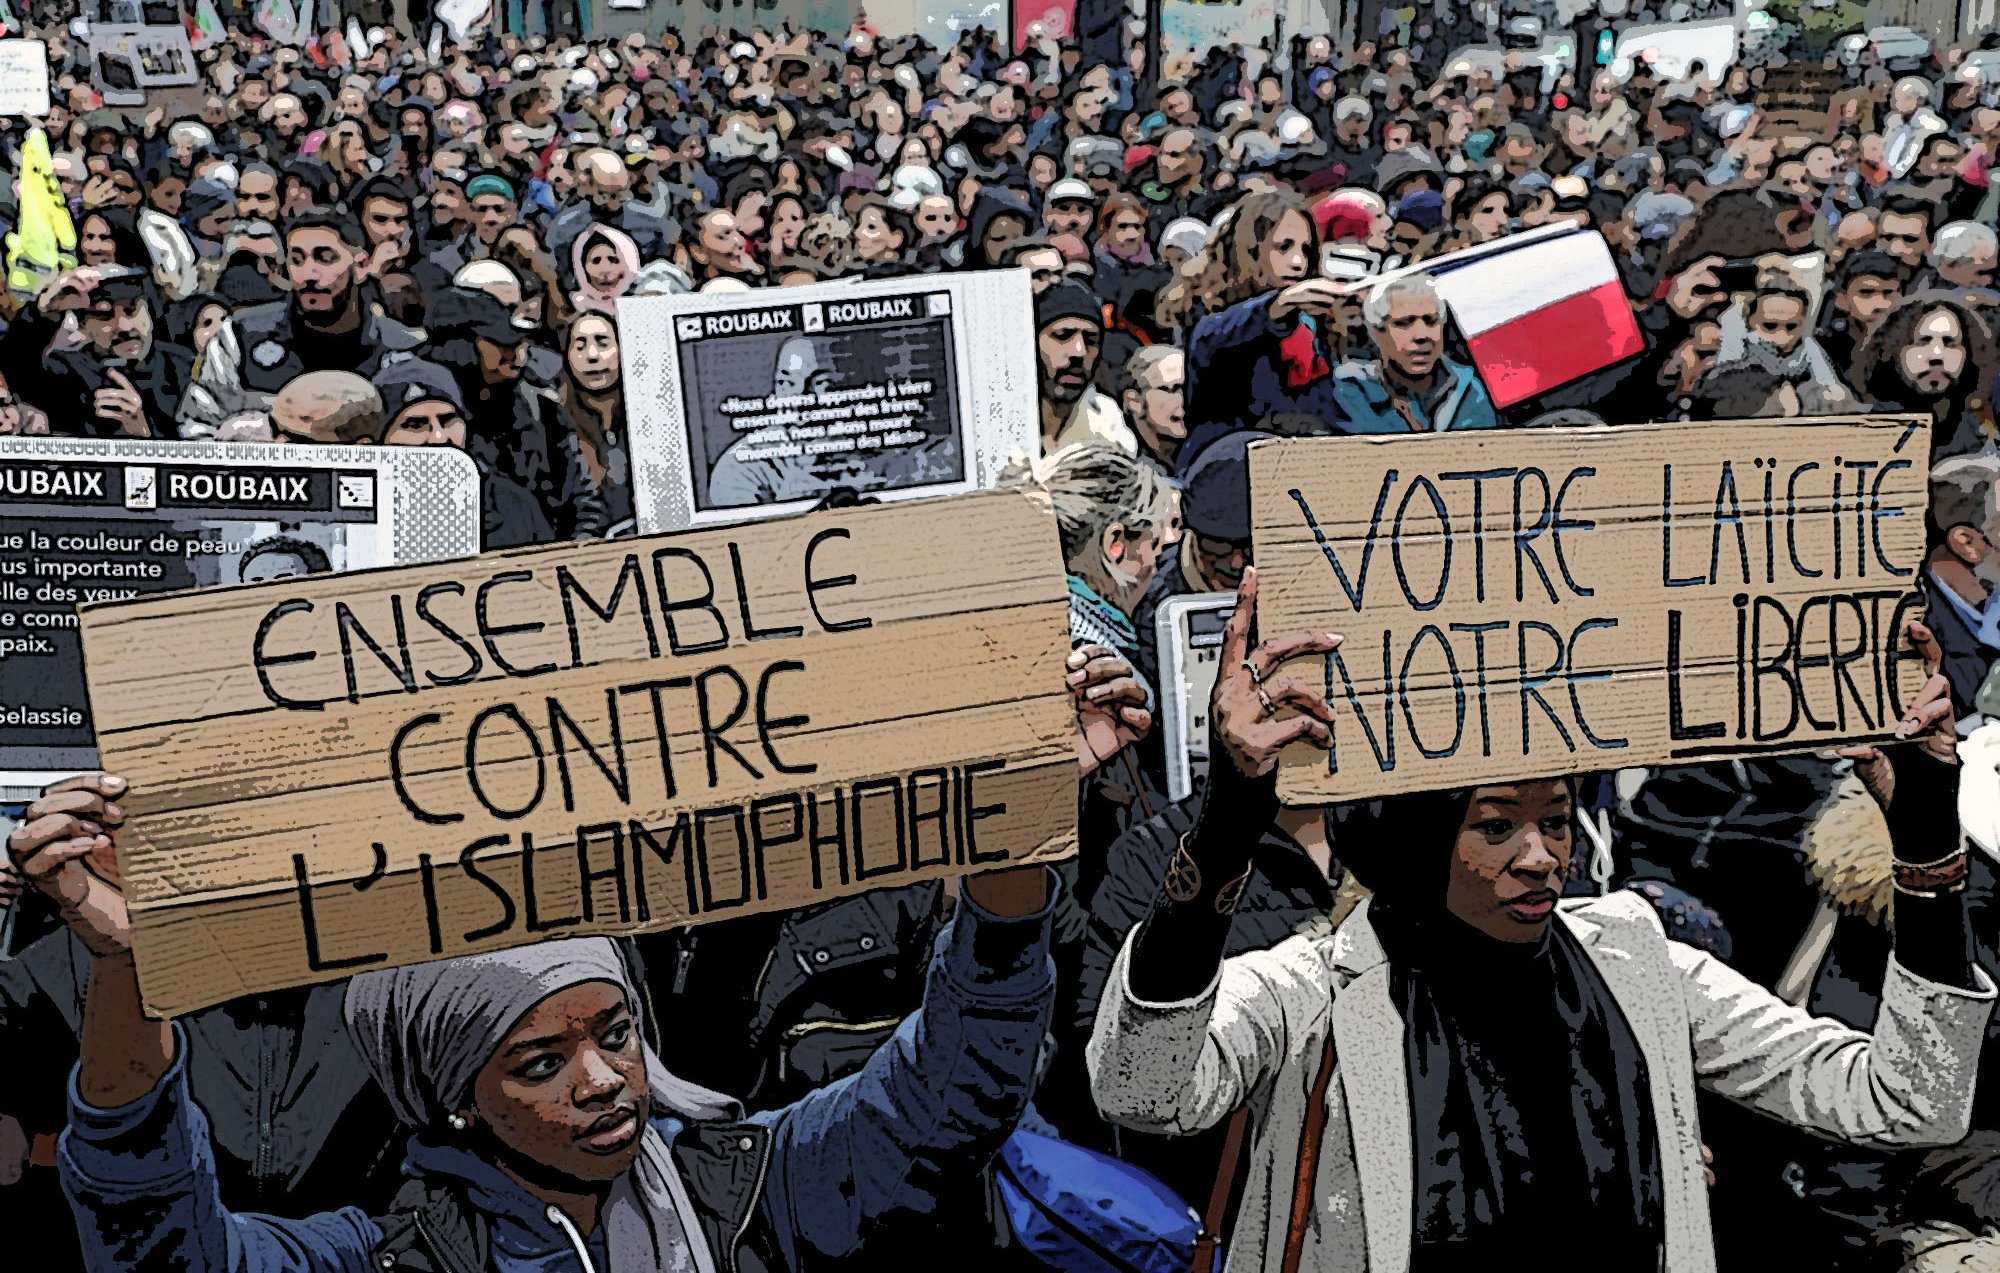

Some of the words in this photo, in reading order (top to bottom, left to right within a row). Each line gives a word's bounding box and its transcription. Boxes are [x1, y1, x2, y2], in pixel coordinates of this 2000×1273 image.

[706, 309, 793, 334] ROUBAIX
[828, 298, 912, 323] ROUBAIX
[0, 469, 103, 496] UBAIX
[170, 474, 309, 502] ROUBAIX
[31, 530, 50, 550] la
[57, 531, 143, 551] couleur
[150, 533, 179, 552] de
[186, 539, 241, 559] peau
[1288, 466, 1596, 611] VOTRE
[34, 558, 162, 581] importante
[0, 581, 29, 600] lle
[36, 582, 77, 601] des
[22, 612, 79, 628] conn
[254, 528, 872, 711] ENSEMBLE
[0, 635, 54, 657] paix.
[1325, 617, 1628, 774] NOTRE
[390, 660, 817, 825] CONTRE
[293, 758, 1010, 971] L'ISLAMOPHOBIE
